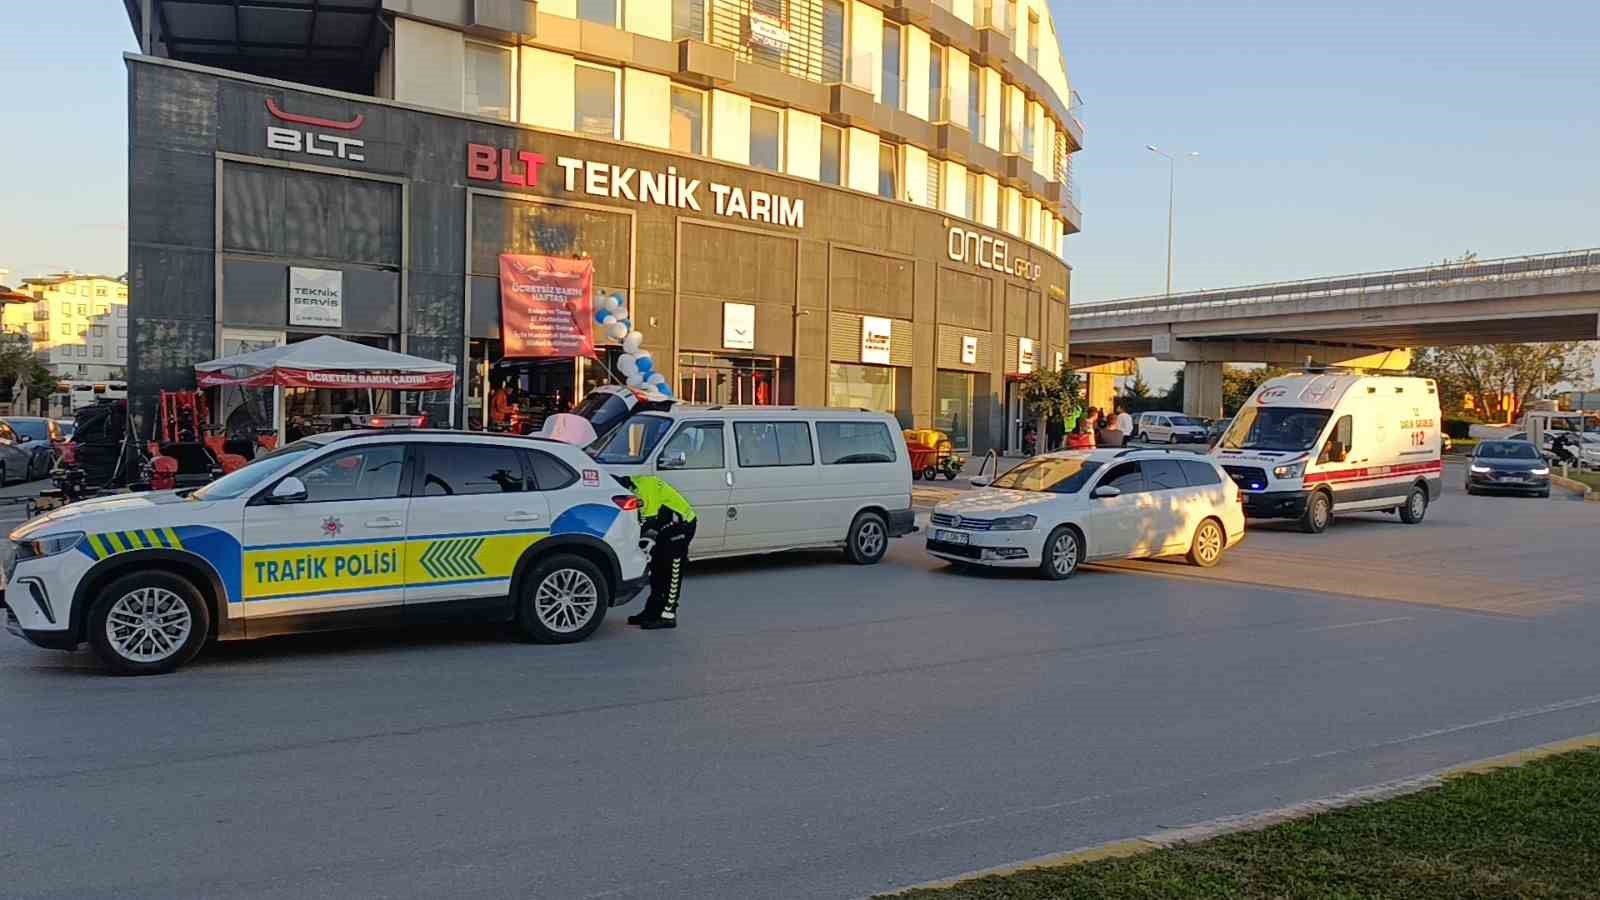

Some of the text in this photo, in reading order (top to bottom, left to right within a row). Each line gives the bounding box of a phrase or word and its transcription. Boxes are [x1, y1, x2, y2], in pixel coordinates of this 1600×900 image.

[467, 143, 805, 228] BLT TEKNİK TARIM
[293, 287, 338, 297] TEKNİK
[293, 297, 338, 307] SERVİS
[306, 371, 357, 384] ÜCRETSİZ
[357, 374, 391, 385] BAKIM
[1411, 430, 1425, 446] 112
[584, 470, 598, 480] 112
[254, 548, 398, 583] TRAFİK POLİSİ
